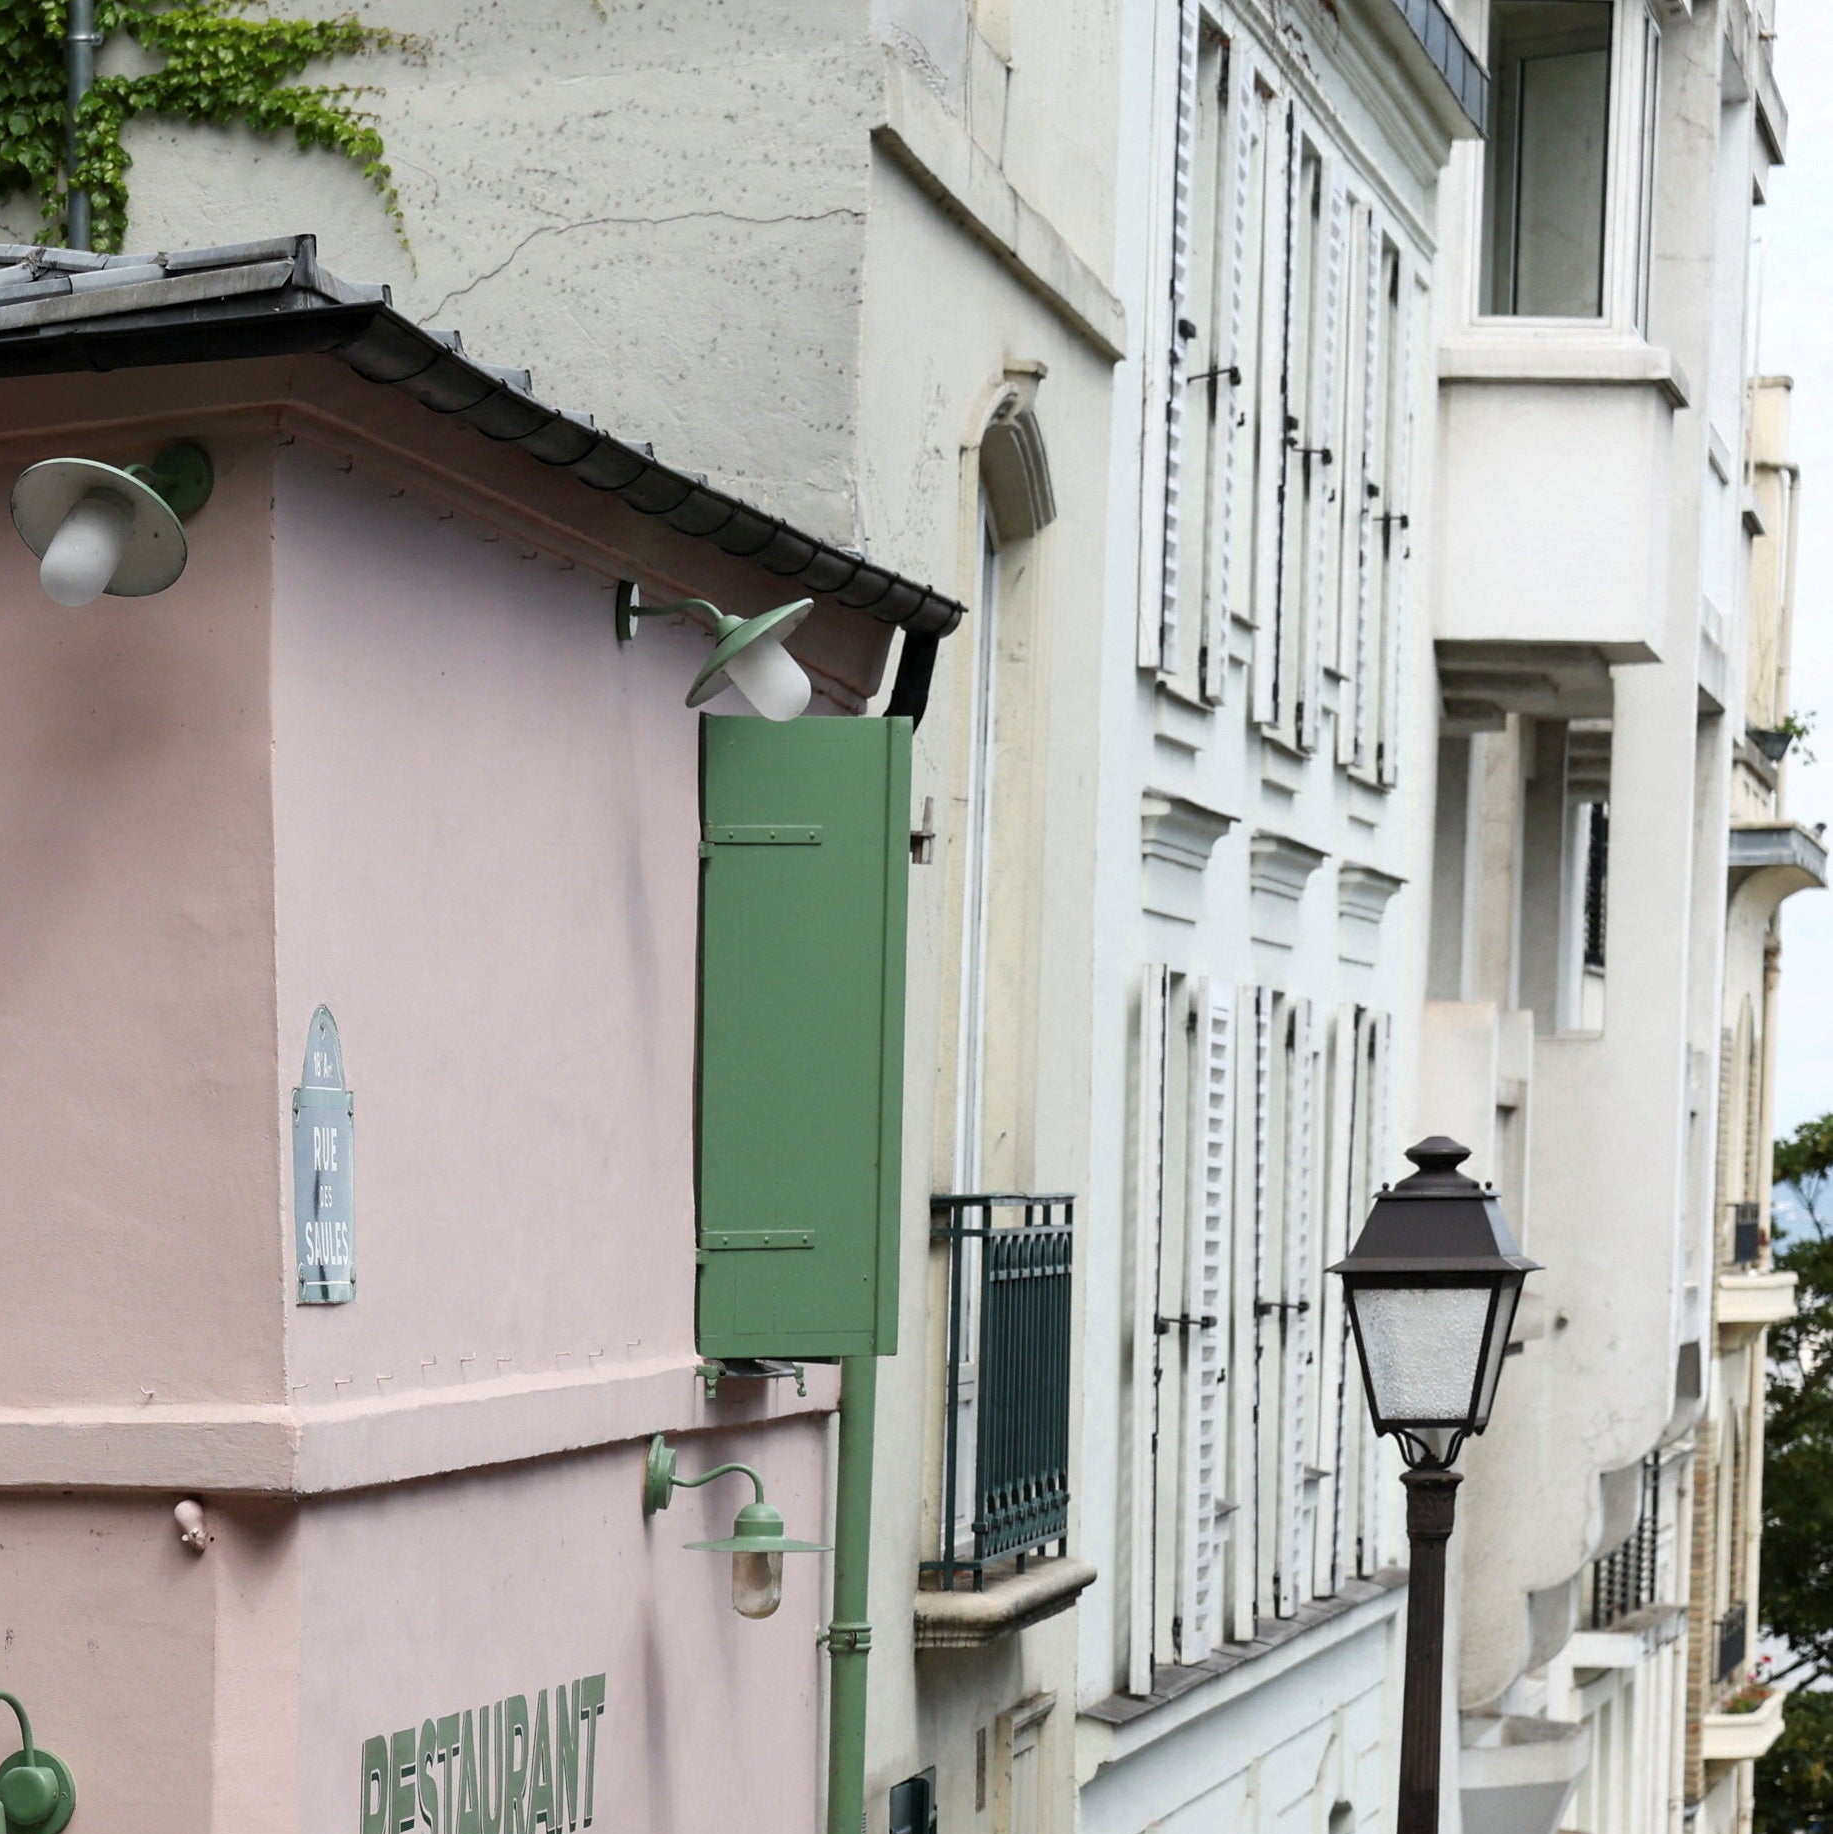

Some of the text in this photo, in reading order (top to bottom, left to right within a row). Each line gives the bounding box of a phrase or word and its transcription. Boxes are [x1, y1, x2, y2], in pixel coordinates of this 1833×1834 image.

[313, 1126, 337, 1172] RUE
[319, 1185, 333, 1208] DES
[305, 1221, 349, 1266] SAULES
